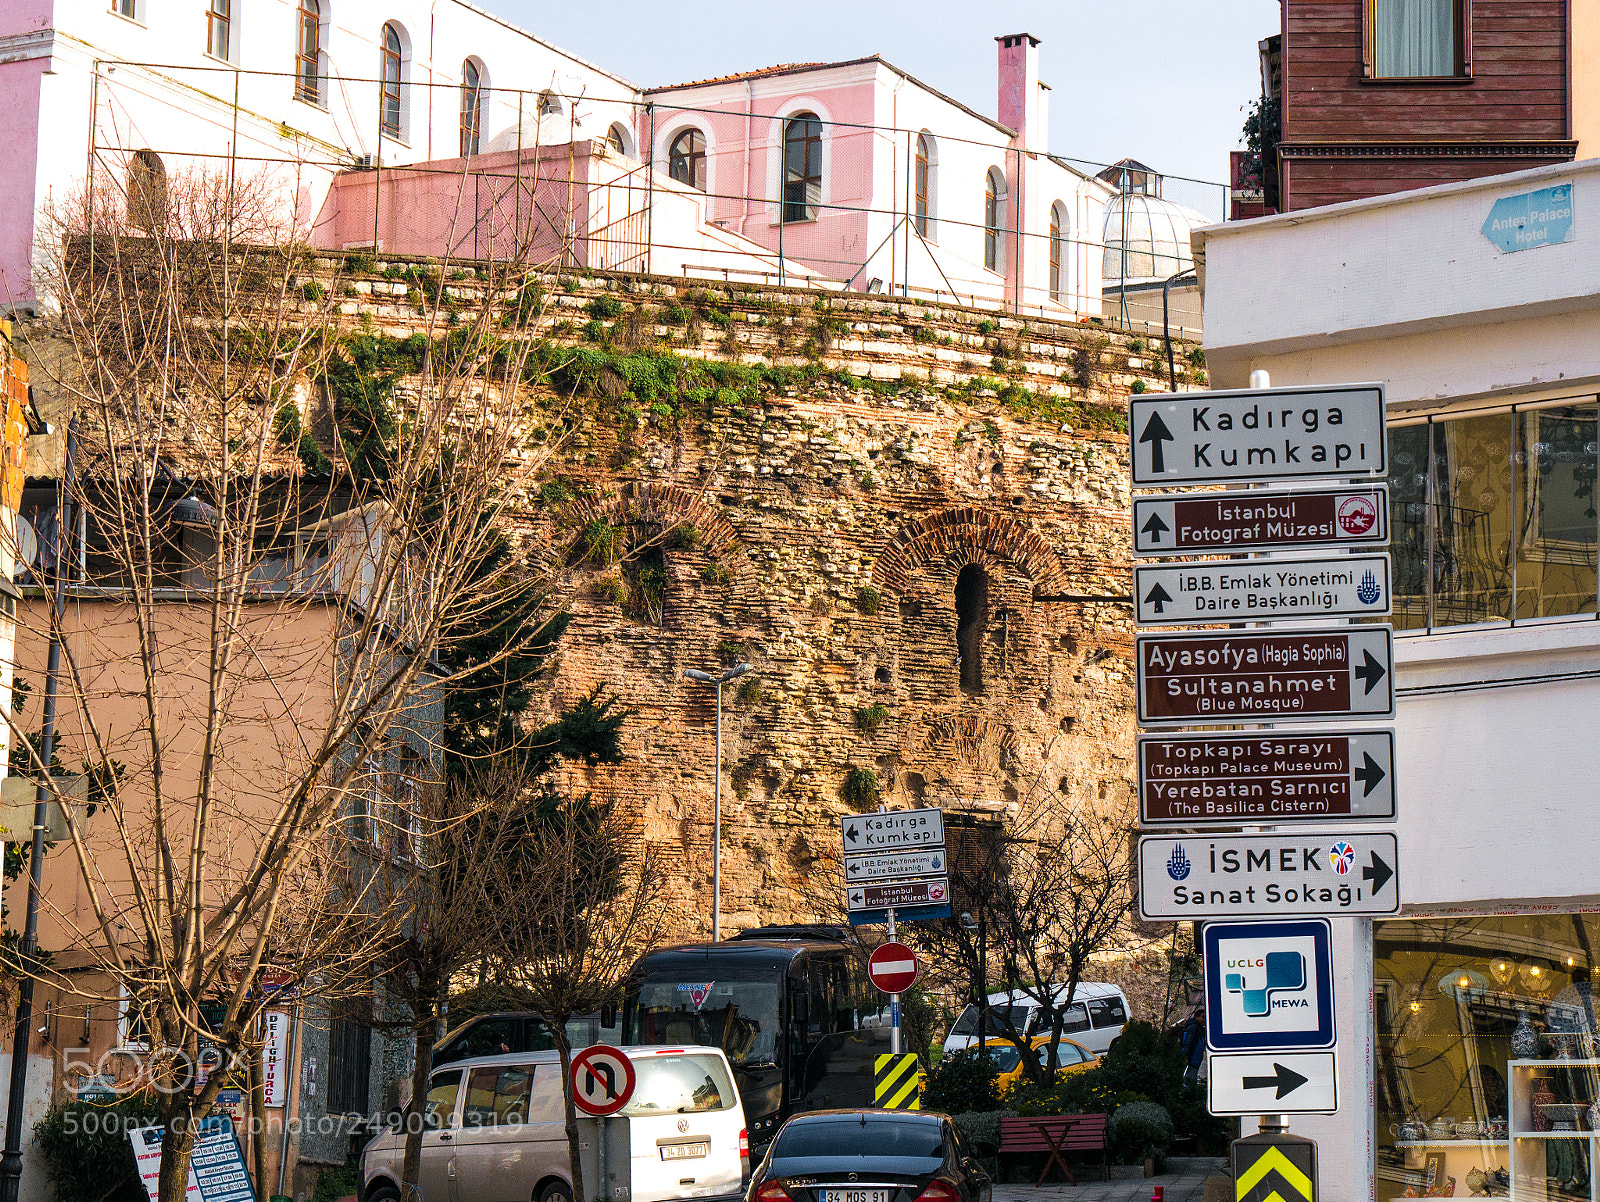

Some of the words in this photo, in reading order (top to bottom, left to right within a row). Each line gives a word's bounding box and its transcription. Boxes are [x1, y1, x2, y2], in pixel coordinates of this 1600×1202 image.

[1491, 216, 1527, 231] Antea
[1530, 208, 1571, 224] Palace
[1516, 227, 1547, 244] Hotel
[1192, 404, 1344, 433] Kadırga
[1194, 439, 1366, 468] Kumkapı
[1217, 501, 1296, 521] İstanbul
[1181, 523, 1260, 543] Fotograf
[1267, 520, 1334, 538] Müzesi
[1179, 573, 1215, 592] İ.B.B.
[1220, 573, 1271, 590] Emlak
[1276, 570, 1353, 587] Yönetimi
[1195, 595, 1241, 611] Daire
[1247, 591, 1339, 609] Başkanlığı
[1149, 641, 1258, 672] Ayasofya
[1262, 642, 1299, 664] (Hagia
[1302, 640, 1346, 666] Sophia)
[1167, 675, 1337, 697] Sultanahmet
[1196, 696, 1236, 712] (Blue
[1241, 694, 1305, 711] Mosque)
[1161, 743, 1252, 761] Topkapı
[1260, 740, 1332, 759] Sarayı
[1151, 763, 1215, 777] (Topkapı
[1220, 760, 1271, 774] Palace
[1273, 758, 1343, 773] Museum)
[1153, 781, 1263, 799] Yerebatan
[1270, 779, 1346, 797] Sarnıcı
[1168, 801, 1201, 816] (The
[1206, 799, 1265, 814] Basilica
[1270, 798, 1329, 812] Cistern)
[865, 815, 927, 830] Kadırga
[866, 830, 936, 845] Kumkapı
[1209, 843, 1323, 873] İSMEK
[1174, 884, 1256, 906] Sanat
[1266, 883, 1360, 907] Sokağı
[1227, 958, 1264, 969] UCLG
[1272, 997, 1308, 1008] MEWA
[827, 1192, 841, 1202] 34
[846, 1192, 867, 1202] MOS
[872, 1192, 885, 1202] 91
